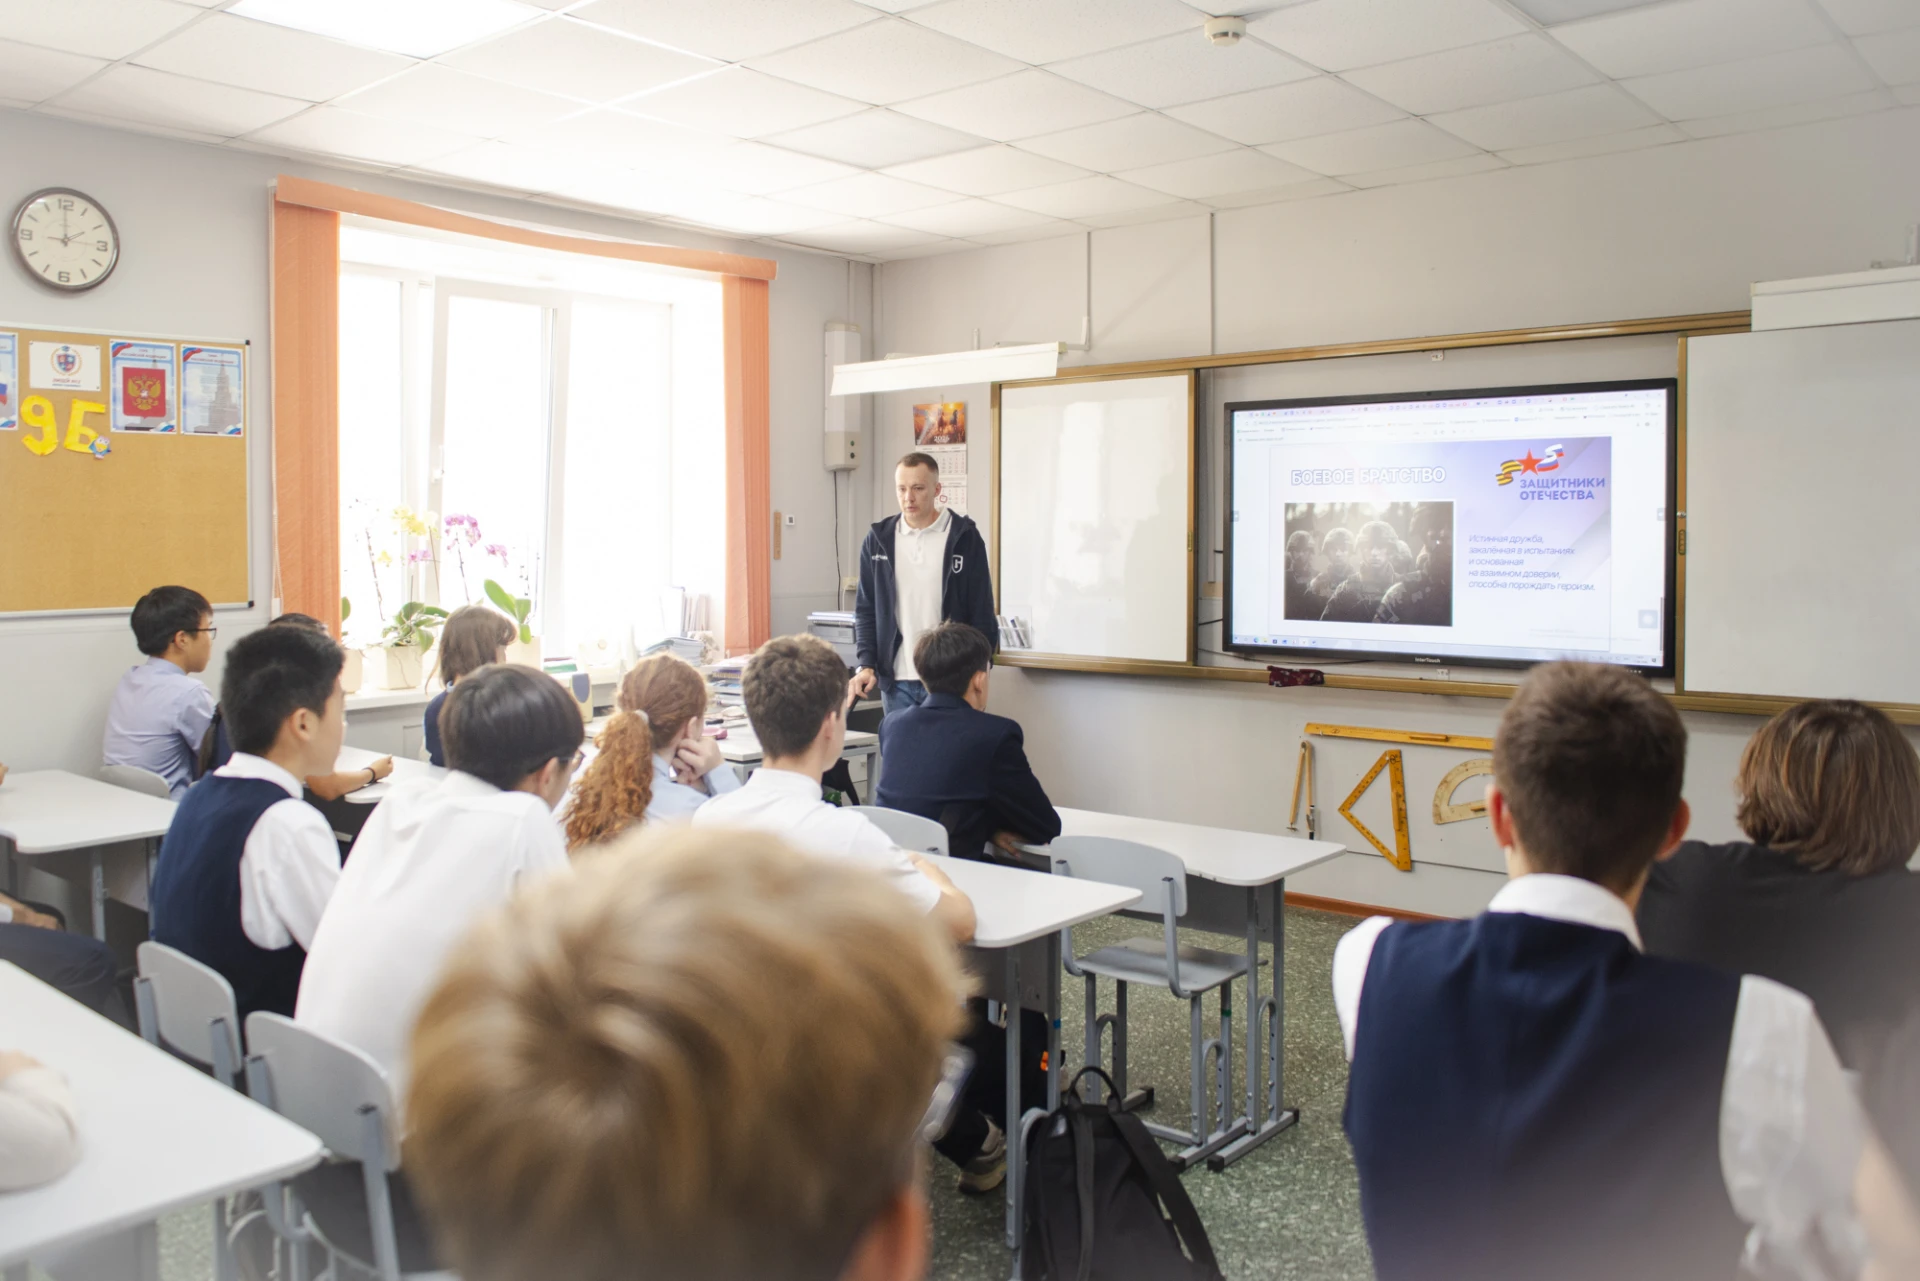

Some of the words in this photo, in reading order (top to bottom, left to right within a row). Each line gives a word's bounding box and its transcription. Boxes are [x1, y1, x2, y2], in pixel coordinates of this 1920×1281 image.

[57, 198, 75, 211] 12
[20, 228, 33, 241] 9
[96, 240, 109, 252] 3
[57, 271, 70, 283] 6
[1291, 468, 1354, 486] БОЕВОЕ
[1359, 466, 1446, 484] БРАТСТВО
[1520, 477, 1605, 489] ЗАЩИТНИКИ
[1520, 490, 1595, 500] ОТЕЧЕСТВА
[1468, 534, 1508, 543] Истинная
[1509, 534, 1544, 544] дружба,
[1468, 546, 1515, 554] закалённая
[1475, 558, 1524, 566] основанная
[1480, 570, 1521, 578] взаимном
[1522, 571, 1561, 580] доверии,
[1468, 580, 1507, 588] способна
[1508, 582, 1556, 590] порождать
[1557, 583, 1596, 591] героизм.
